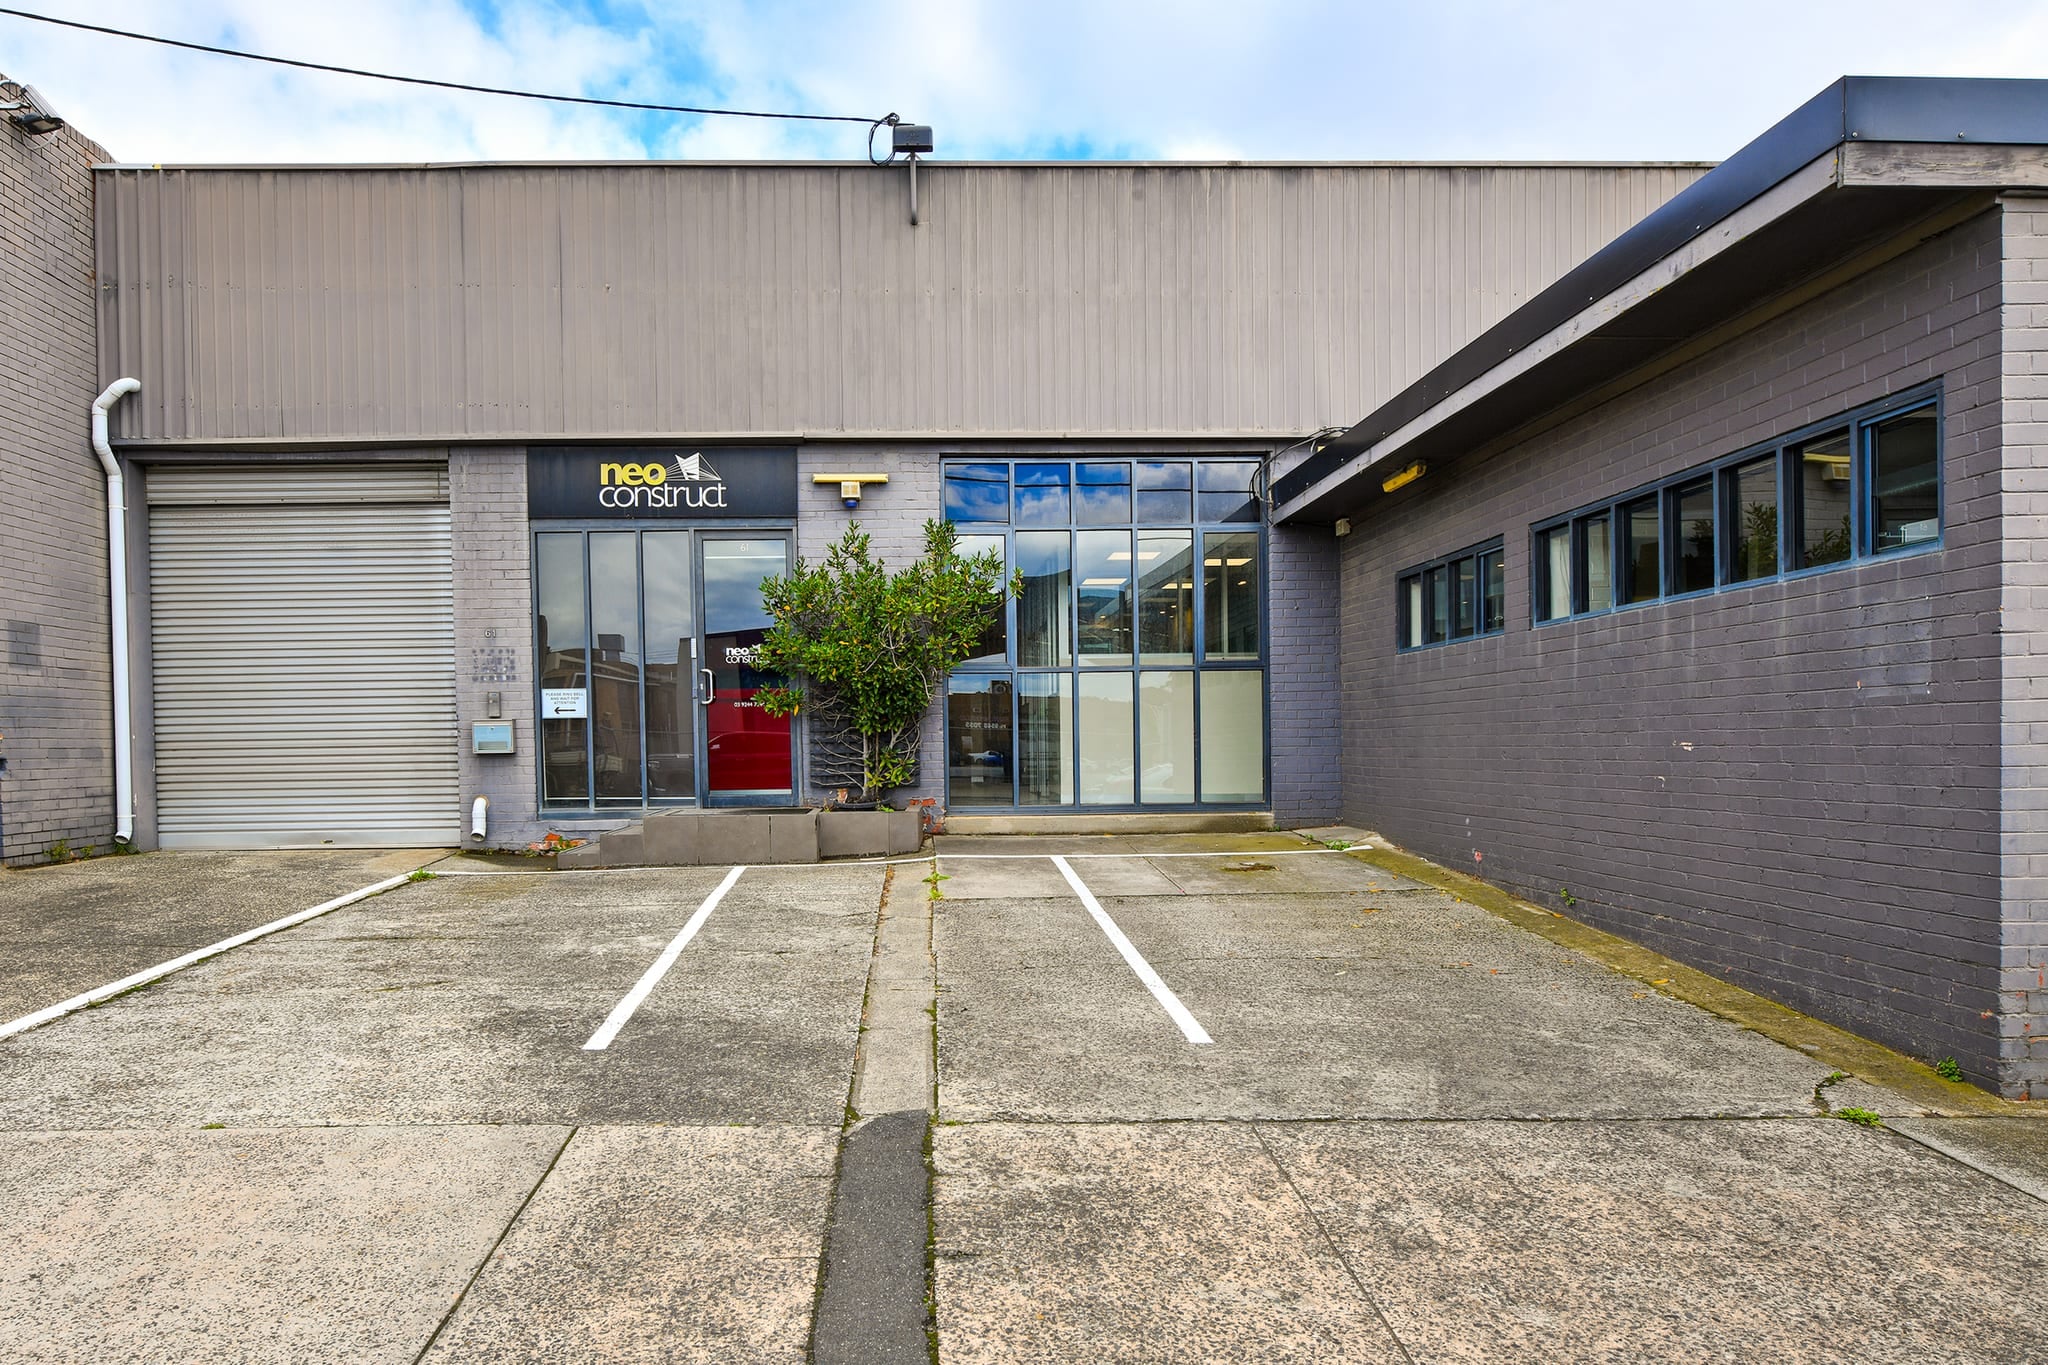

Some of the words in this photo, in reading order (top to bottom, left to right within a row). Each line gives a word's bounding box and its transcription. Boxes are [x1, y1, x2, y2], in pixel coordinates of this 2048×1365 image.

[600, 463, 666, 485] neo
[599, 482, 727, 507] construct
[740, 543, 749, 552] 61
[484, 628, 496, 638] 61
[725, 647, 750, 656] neo
[725, 655, 762, 664] constru
